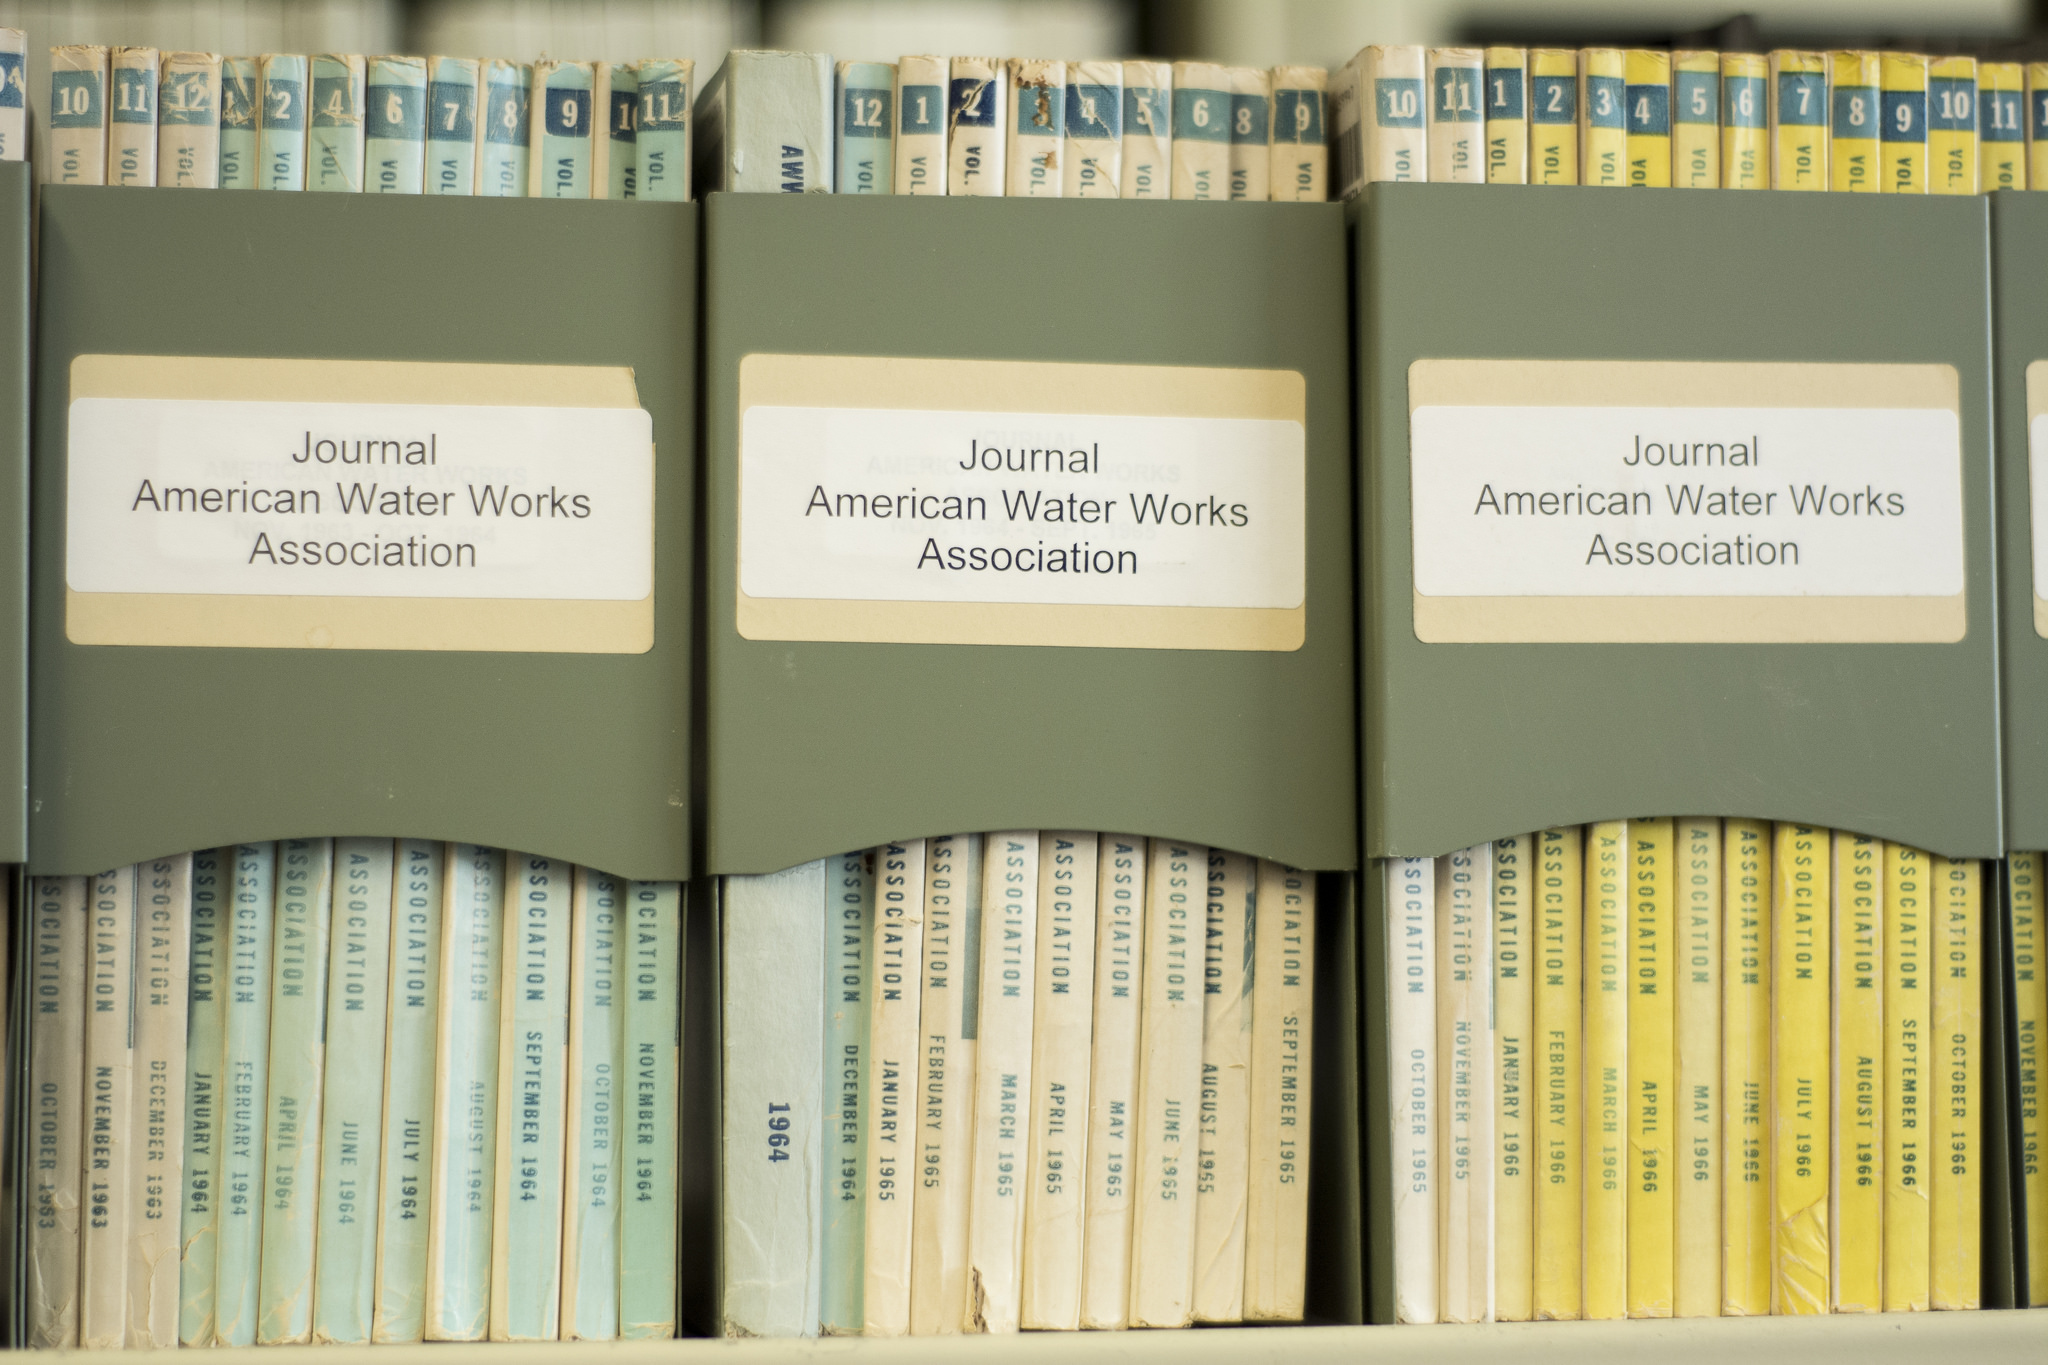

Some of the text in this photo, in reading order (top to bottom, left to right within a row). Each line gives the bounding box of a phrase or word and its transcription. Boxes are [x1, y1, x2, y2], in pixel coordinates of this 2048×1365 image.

[60, 87, 89, 115] 10
[119, 83, 147, 112] 11
[277, 91, 290, 119] 2
[329, 90, 343, 115] 4
[386, 93, 403, 124] 6
[562, 100, 578, 127] 9
[643, 95, 671, 121] 11
[854, 98, 883, 127] 12
[916, 97, 929, 124] 1
[1081, 98, 1095, 125] 4
[1193, 100, 1208, 127] 6
[1388, 89, 1417, 117] 10
[1443, 83, 1472, 110] 11
[1494, 79, 1506, 106] 1
[1548, 86, 1562, 112] 2
[1597, 88, 1611, 115] 3
[1634, 97, 1650, 124] 4
[1693, 88, 1706, 115] 5
[1739, 89, 1753, 116] 6
[1798, 88, 1811, 116] 7
[1849, 97, 1865, 126] 8
[1941, 90, 1969, 120] 10
[1991, 100, 2017, 129] 11
[445, 104, 460, 130] 7
[504, 102, 518, 128] 8
[1237, 107, 1252, 134] 8
[1296, 104, 1309, 131] 9
[1896, 104, 1912, 133] 9
[292, 431, 437, 465] Journal
[959, 439, 1099, 474] Journal
[1623, 434, 1759, 467] Journal
[132, 479, 592, 519] American Water Works
[806, 485, 1250, 527] American Water Works
[1475, 484, 1906, 517] American Water Works
[248, 533, 477, 568] Association
[918, 538, 1138, 574] Association
[1585, 533, 1800, 566] Association
[1168, 847, 1188, 1002] ASSOCIATION
[1637, 840, 1657, 996] ASSOCIATION
[1740, 831, 1759, 985] ASSOCIATION
[152, 862, 171, 1006] SSOCIATION
[878, 841, 906, 1201] ASSOCIATION JANUARY 1965
[997, 841, 1025, 1198] ASSOCIATION MARCH 1965
[1046, 838, 1074, 1195] ASSOCIATION APRIL 1965
[1107, 843, 1133, 1198] ASSOCIATION MAY 1965
[1499, 837, 1520, 1178] SSOCIATION JANUARY 1966
[1545, 831, 1566, 1184] ASSOCIATION FEBRUARY 1966
[1600, 836, 1618, 1190] ASSOCIATION MARCH 1966
[1691, 829, 1710, 1182] ASSOCIATION MAY 1966
[1794, 826, 1813, 1178] ASSOCIATION JULY 1966
[1853, 834, 1874, 1187] ASSOCIATION AUGUST 1966
[1899, 846, 1918, 1186] SSOCIATION SEPTEMBER 1966
[91, 868, 116, 1229] SSOCIATION NOVEMBER 1963
[231, 848, 258, 1216] ASSOCIATION FEBRUARY 1964
[338, 854, 369, 1224] ASSOCIATION JUNE 1964
[400, 850, 429, 1220] ASSOCIATION JULY 1964
[520, 858, 548, 1202] SSOCIATION SEPTEMBER 1964
[926, 1035, 946, 1130] FEBRUARY
[2020, 1020, 2036, 1121] NOVEMBER
[194, 1072, 212, 1155] JANUARY
[841, 1044, 858, 1144] DECEMBER
[1200, 1064, 1218, 1136] AUGUST
[1279, 1016, 1298, 1185] SEPTEMBER 1965
[1641, 1081, 1657, 1135] APRIL
[1951, 1033, 1966, 1175] OCTOBER 1966
[39, 1083, 57, 1170] OCTOBER
[278, 1096, 297, 1152] APRIL
[591, 1063, 611, 1207] OCTOBER 1964
[636, 1043, 655, 1203] NOVEMBER 1964
[766, 1101, 791, 1164] 1964
[1163, 1099, 1181, 1142] JUNE
[1410, 1049, 1427, 1194] OCTOBER 1965
[841, 1156, 857, 1202] 1964
[923, 1143, 940, 1187] 1965
[1454, 1135, 1470, 1180] 1965
[1642, 1149, 1658, 1193] 1966
[190, 1169, 209, 1214] 1964
[275, 1164, 292, 1210] 1964
[466, 1167, 482, 1213] 1964
